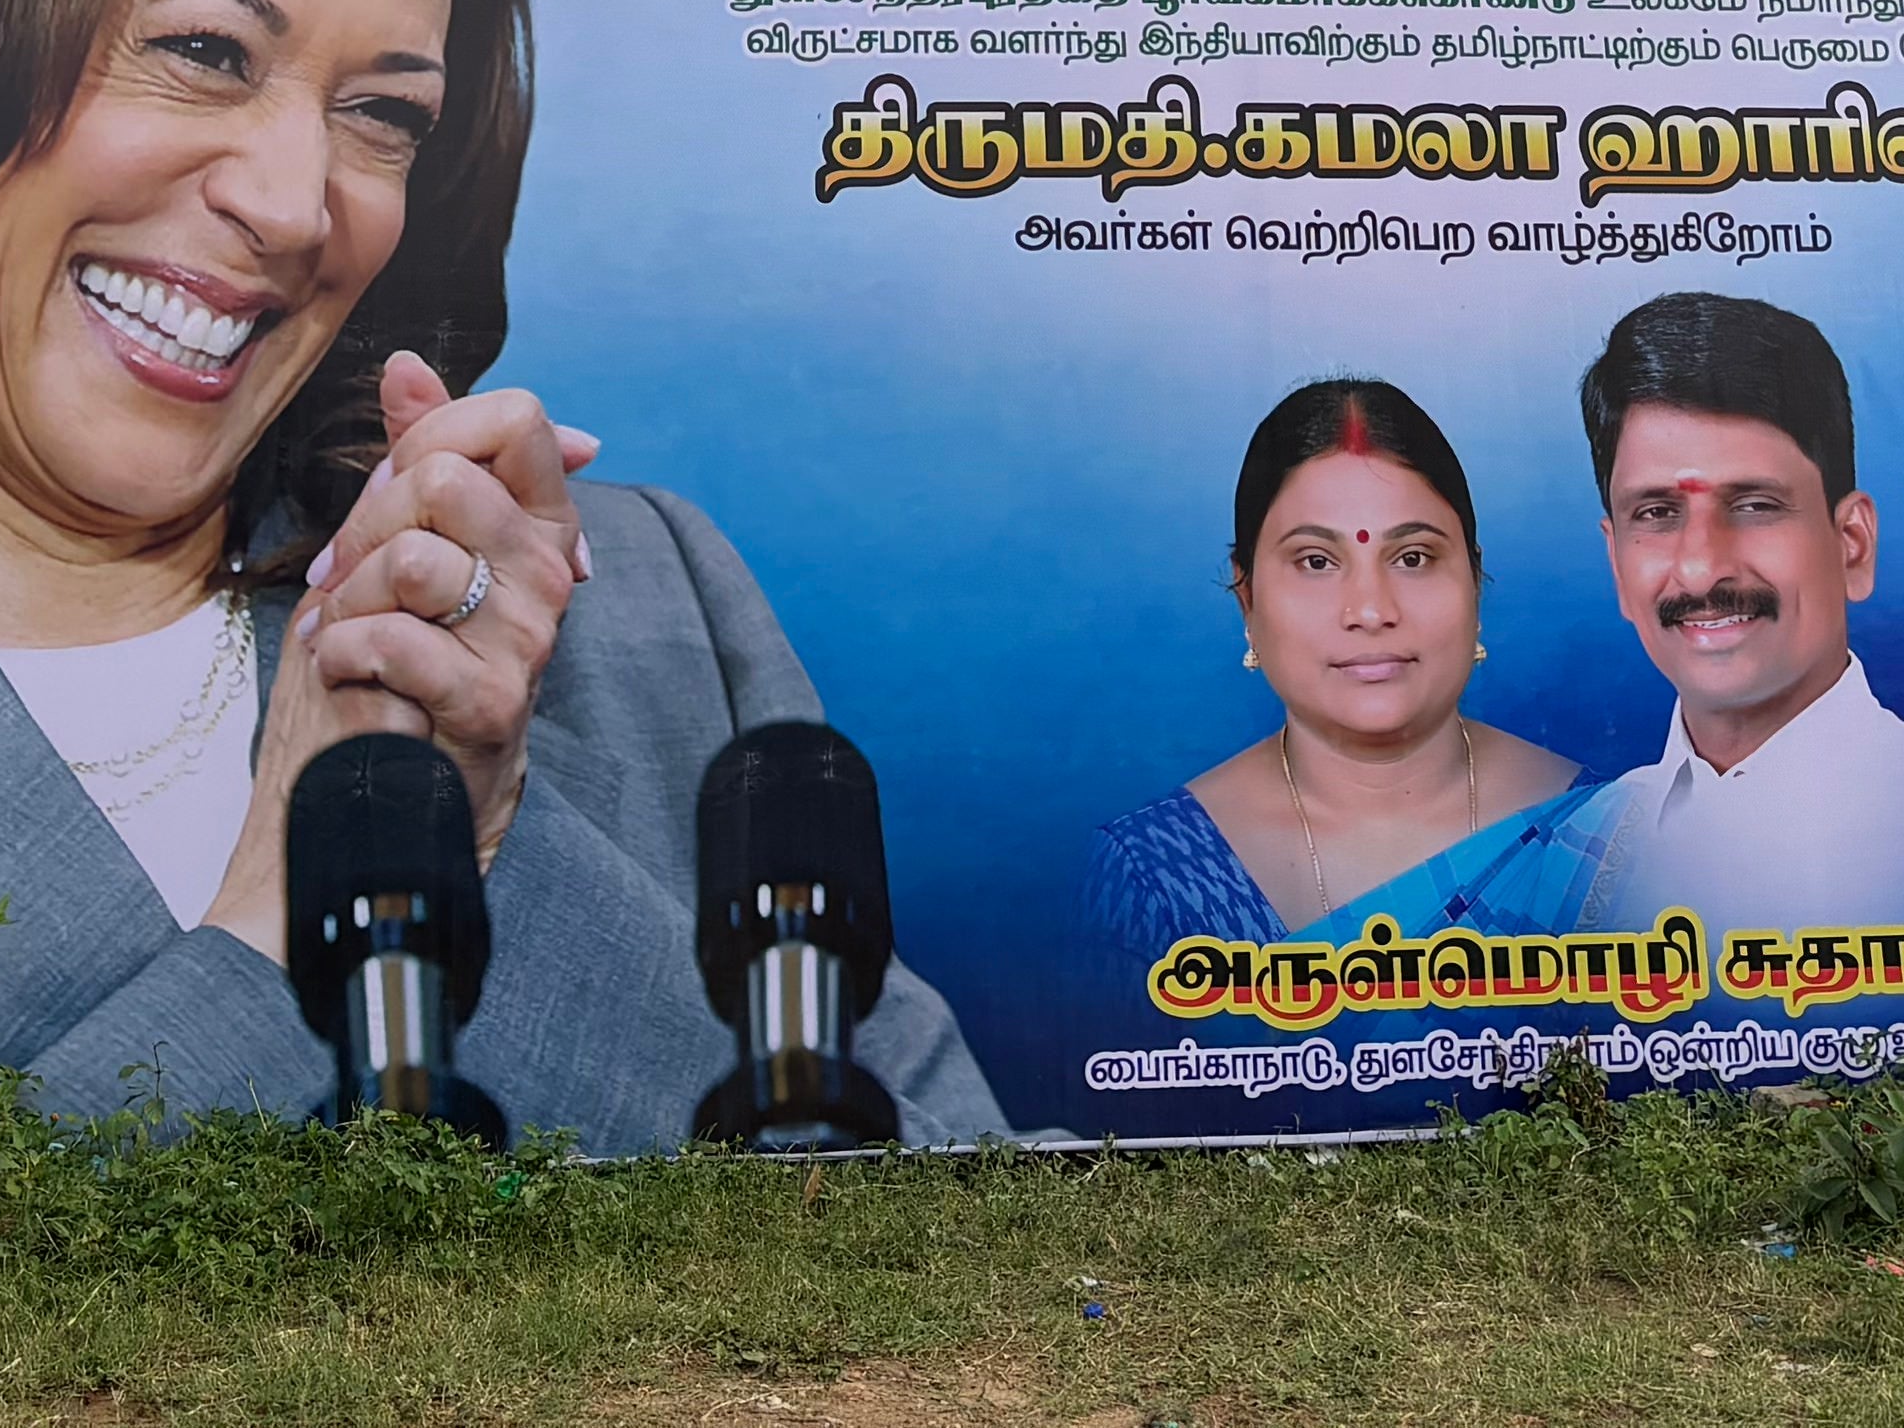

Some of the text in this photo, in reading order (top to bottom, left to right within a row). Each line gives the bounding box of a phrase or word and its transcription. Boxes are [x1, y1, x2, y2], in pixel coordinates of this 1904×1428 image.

[746, 24, 957, 63] விருட்சமாக
[970, 21, 1129, 65] வளர்ந்து
[1138, 20, 1422, 66] இந்தியாவிற்கும்
[1430, 25, 1722, 70] தமிழ்நாட்டிற்கும்
[1731, 30, 1890, 70] பெருமை
[818, 76, 1565, 202] திருமதி.கமலா
[1014, 209, 1834, 266] அவர்கள் வெற்றிபெற வாழ்த்துகிறோம்
[1156, 914, 1702, 1021] அருள்மொழி
[1094, 1040, 1344, 1093] பைங்காநாடு,
[1648, 1026, 1794, 1078] ஒன்றிய
